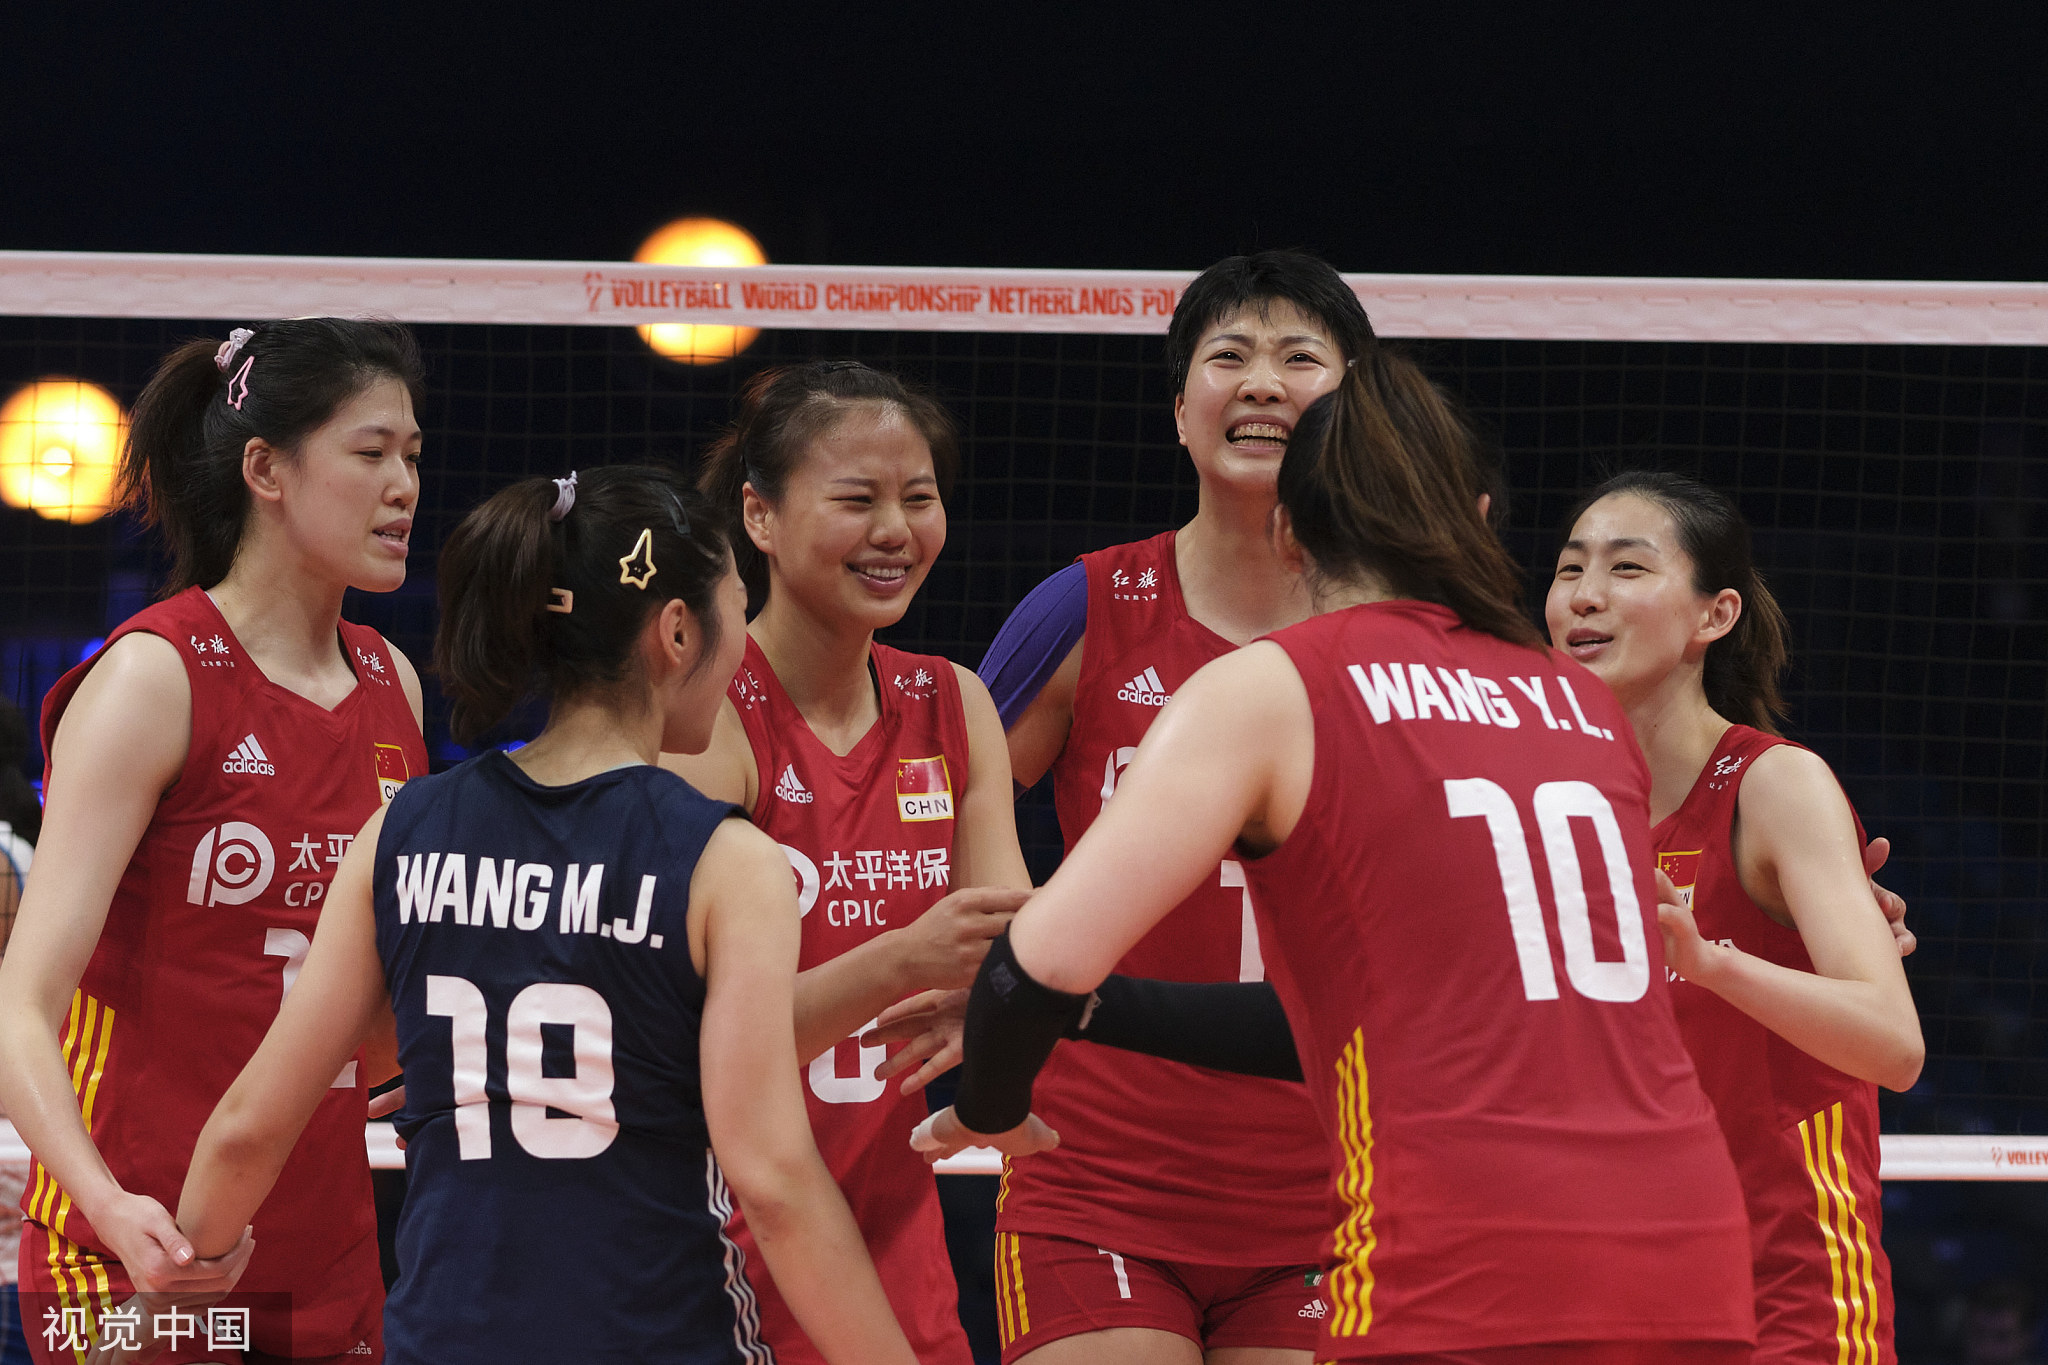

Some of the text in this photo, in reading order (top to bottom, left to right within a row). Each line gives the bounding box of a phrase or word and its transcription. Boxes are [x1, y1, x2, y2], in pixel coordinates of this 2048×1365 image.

[611, 279, 732, 310] VOLLEYBALL
[741, 281, 818, 311] WORLD
[825, 283, 982, 314] CHAMPIONSHIP
[989, 286, 1135, 317] NETHERLANDS
[1111, 567, 1159, 589] 红旗
[1346, 662, 1615, 741] WANG Y.L.
[222, 757, 275, 777] adidas
[775, 784, 814, 805] adidas
[905, 797, 949, 816] CHN
[823, 847, 951, 892] 太平洋保
[396, 852, 664, 949] WANG M.J.
[1443, 777, 1651, 1004] 10
[827, 899, 887, 927] CPIC
[426, 974, 621, 1161] 18
